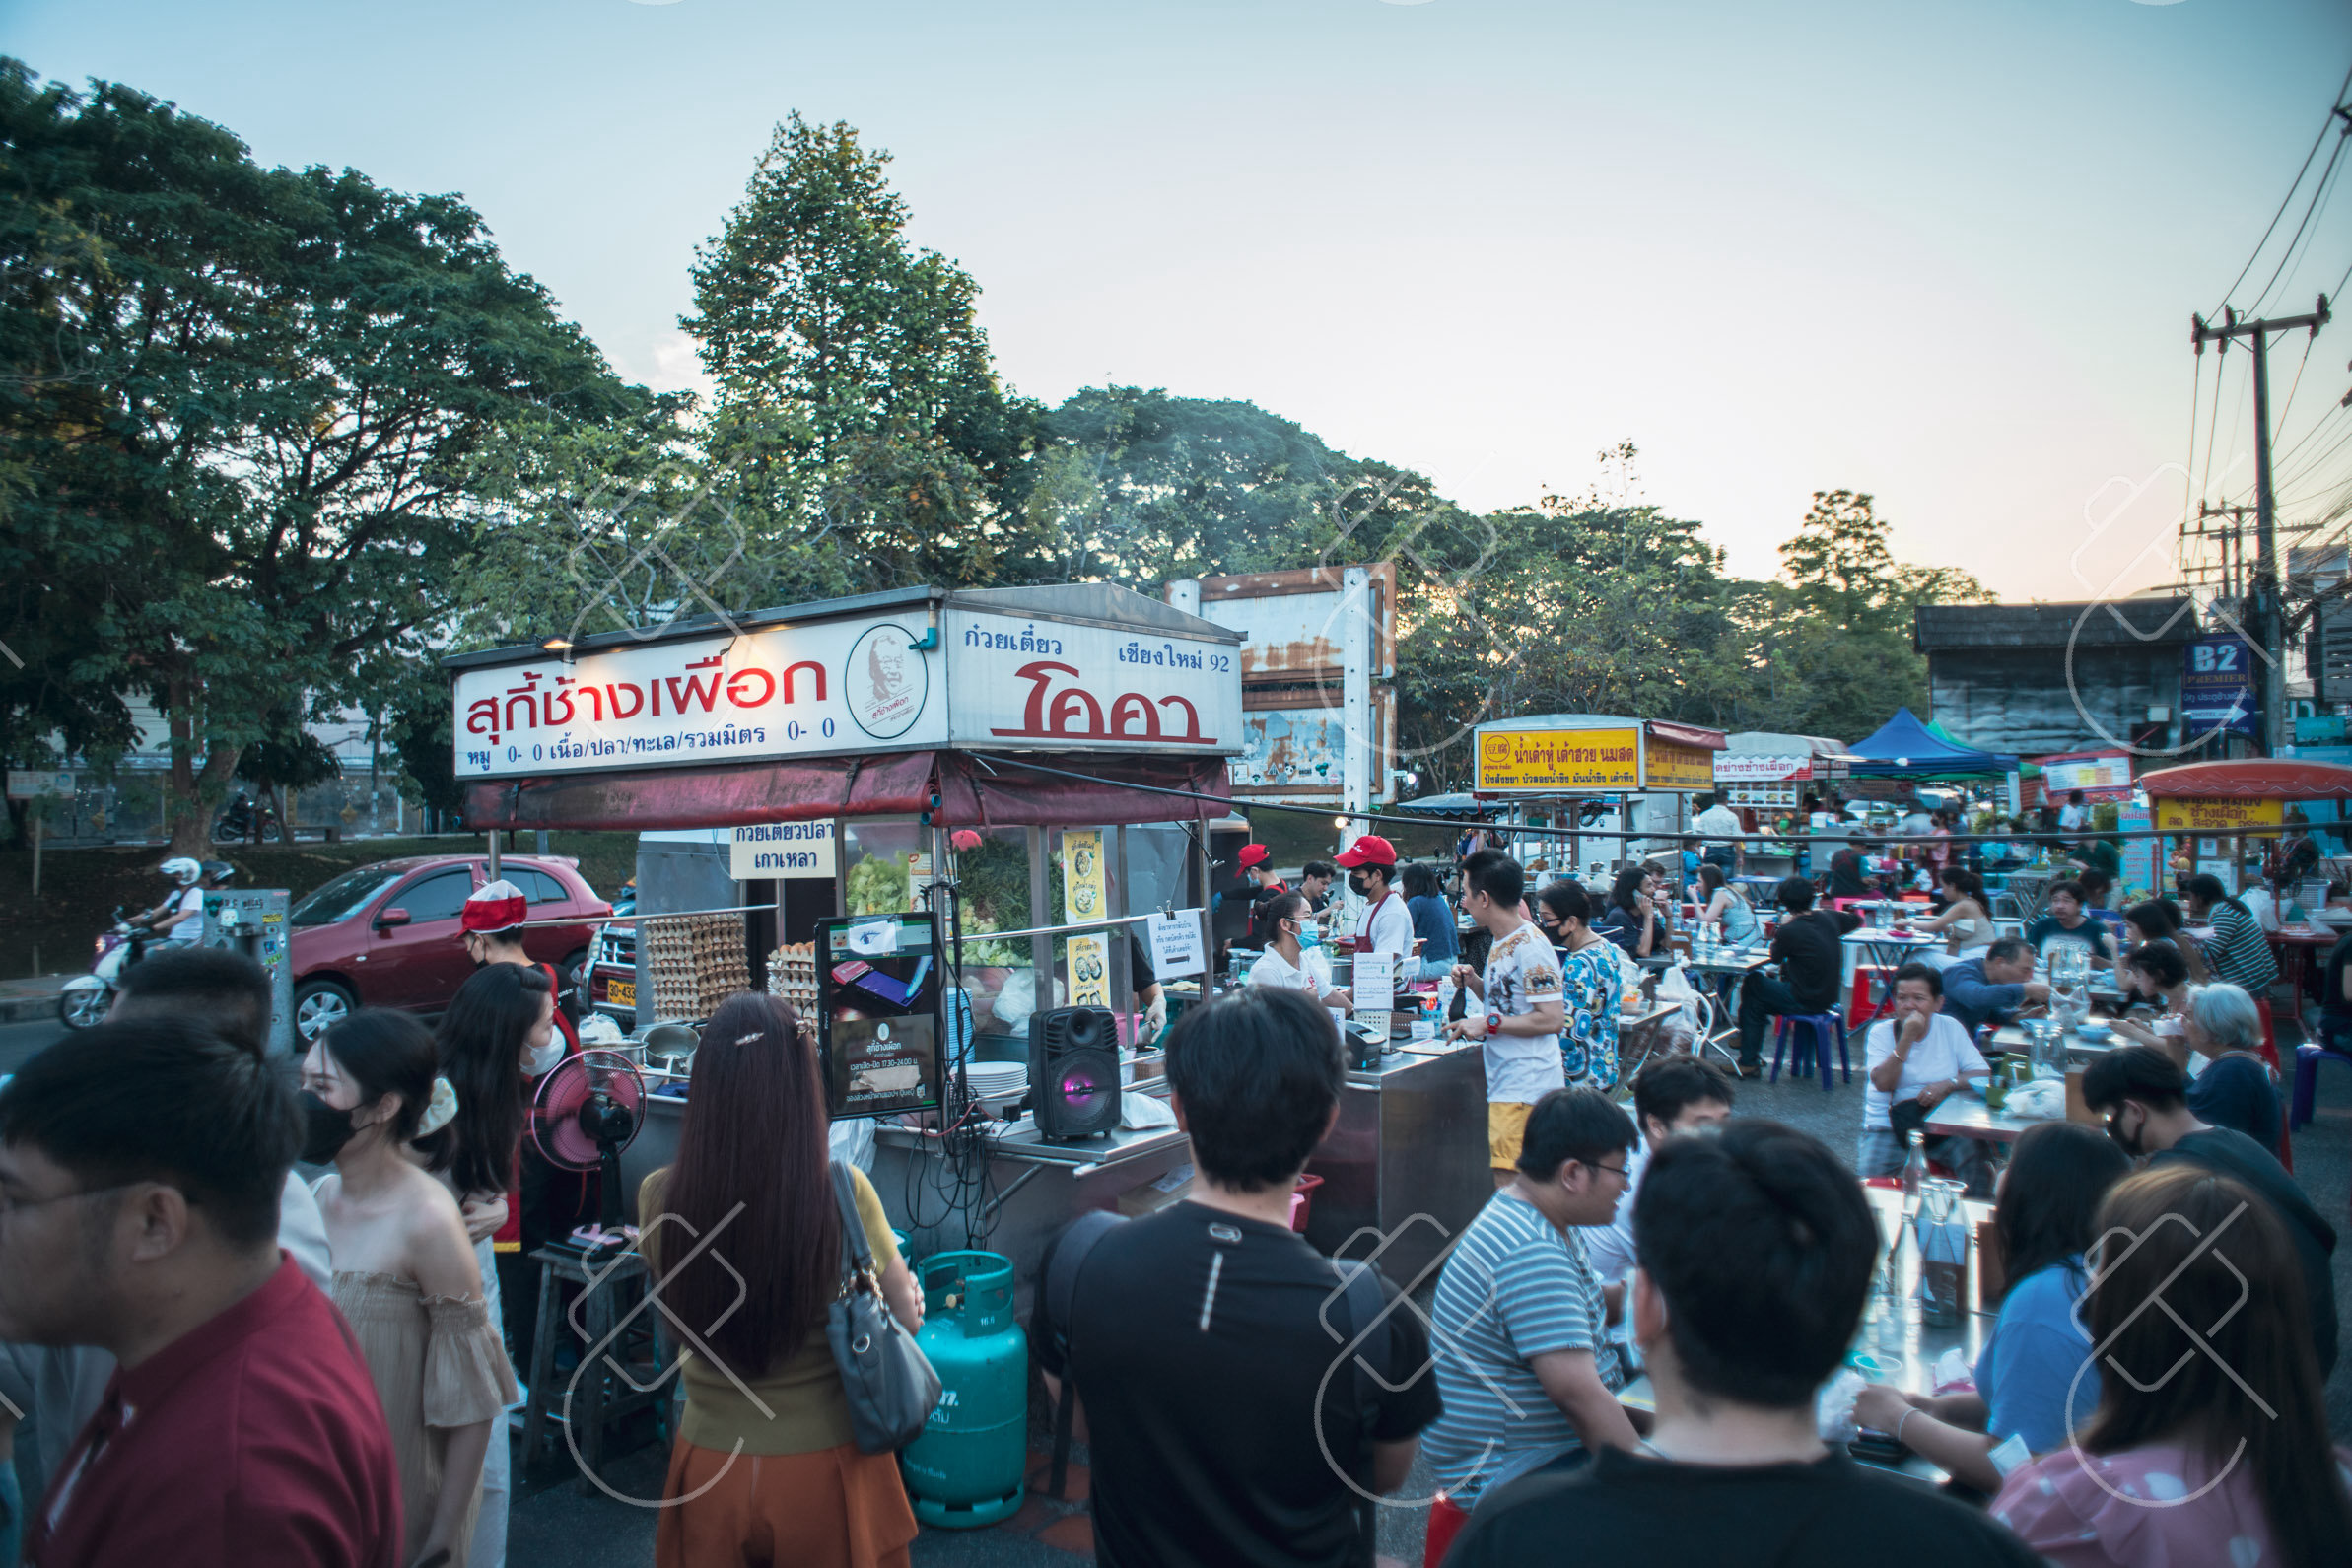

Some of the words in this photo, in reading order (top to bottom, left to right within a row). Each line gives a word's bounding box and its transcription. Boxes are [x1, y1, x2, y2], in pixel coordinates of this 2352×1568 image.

[965, 623, 1062, 655] ก๋วยเตี๋ยว
[1119, 642, 1202, 670] เชียงใหม่
[1210, 654, 1230, 673] 92
[2193, 644, 2238, 672] B2
[2187, 673, 2247, 684] PREMIER
[466, 655, 827, 746] สุกี้ช้างเผือก
[467, 749, 491, 771] หมู
[1514, 736, 1554, 771] น้ำเต้าหู้
[1600, 747, 1634, 763] นมสด
[754, 852, 817, 868] เกาเหลา
